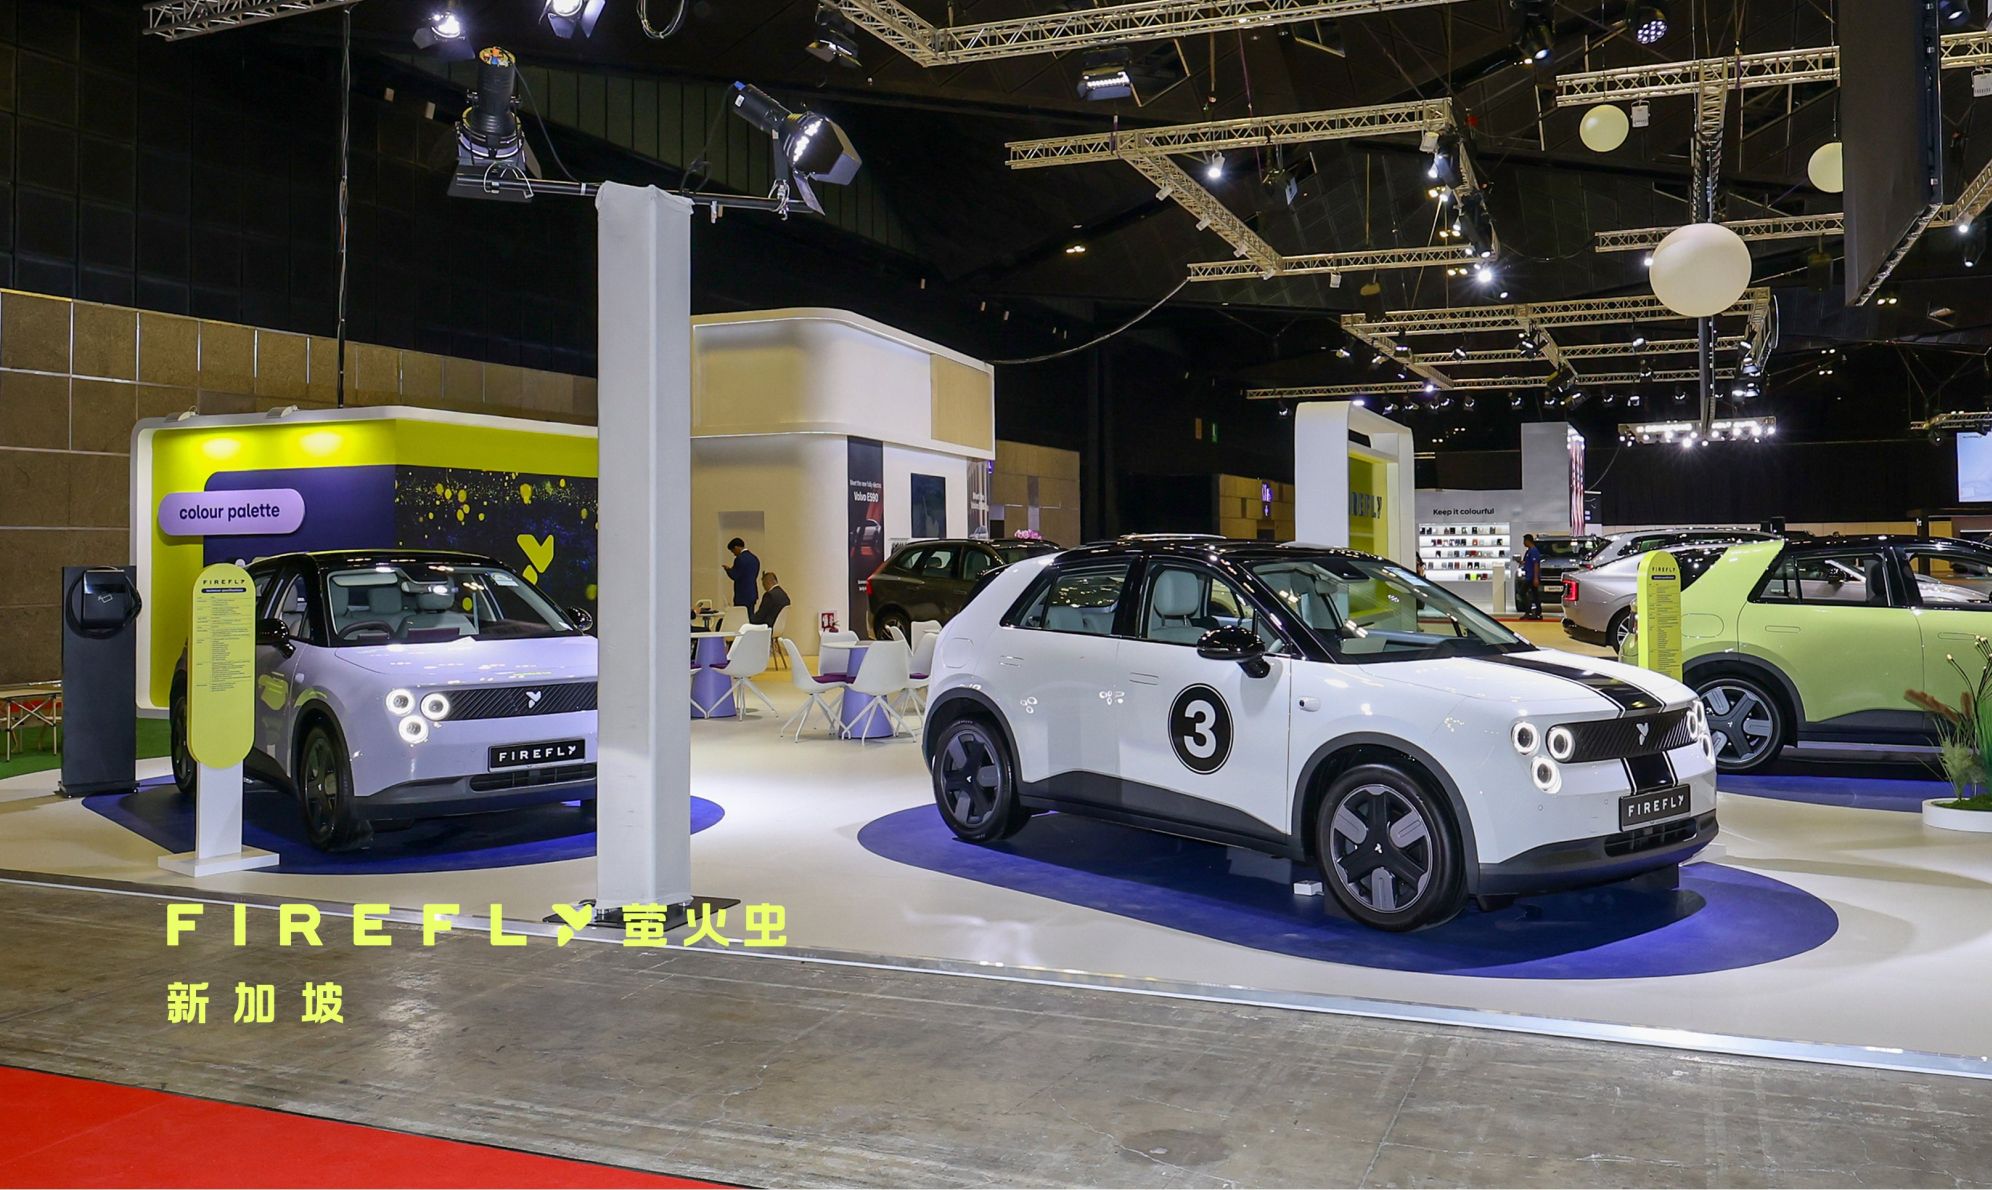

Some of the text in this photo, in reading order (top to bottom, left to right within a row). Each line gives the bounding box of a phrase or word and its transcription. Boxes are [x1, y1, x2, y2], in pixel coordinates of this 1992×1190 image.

[853, 491, 867, 502] Volvo
[1351, 491, 1383, 519] REFLY
[179, 503, 280, 522] colour palette
[1433, 507, 1495, 516] Keep it colourful
[1183, 699, 1217, 759] 3
[499, 745, 576, 762] FIREFLY
[1628, 794, 1684, 817] FIREFLY
